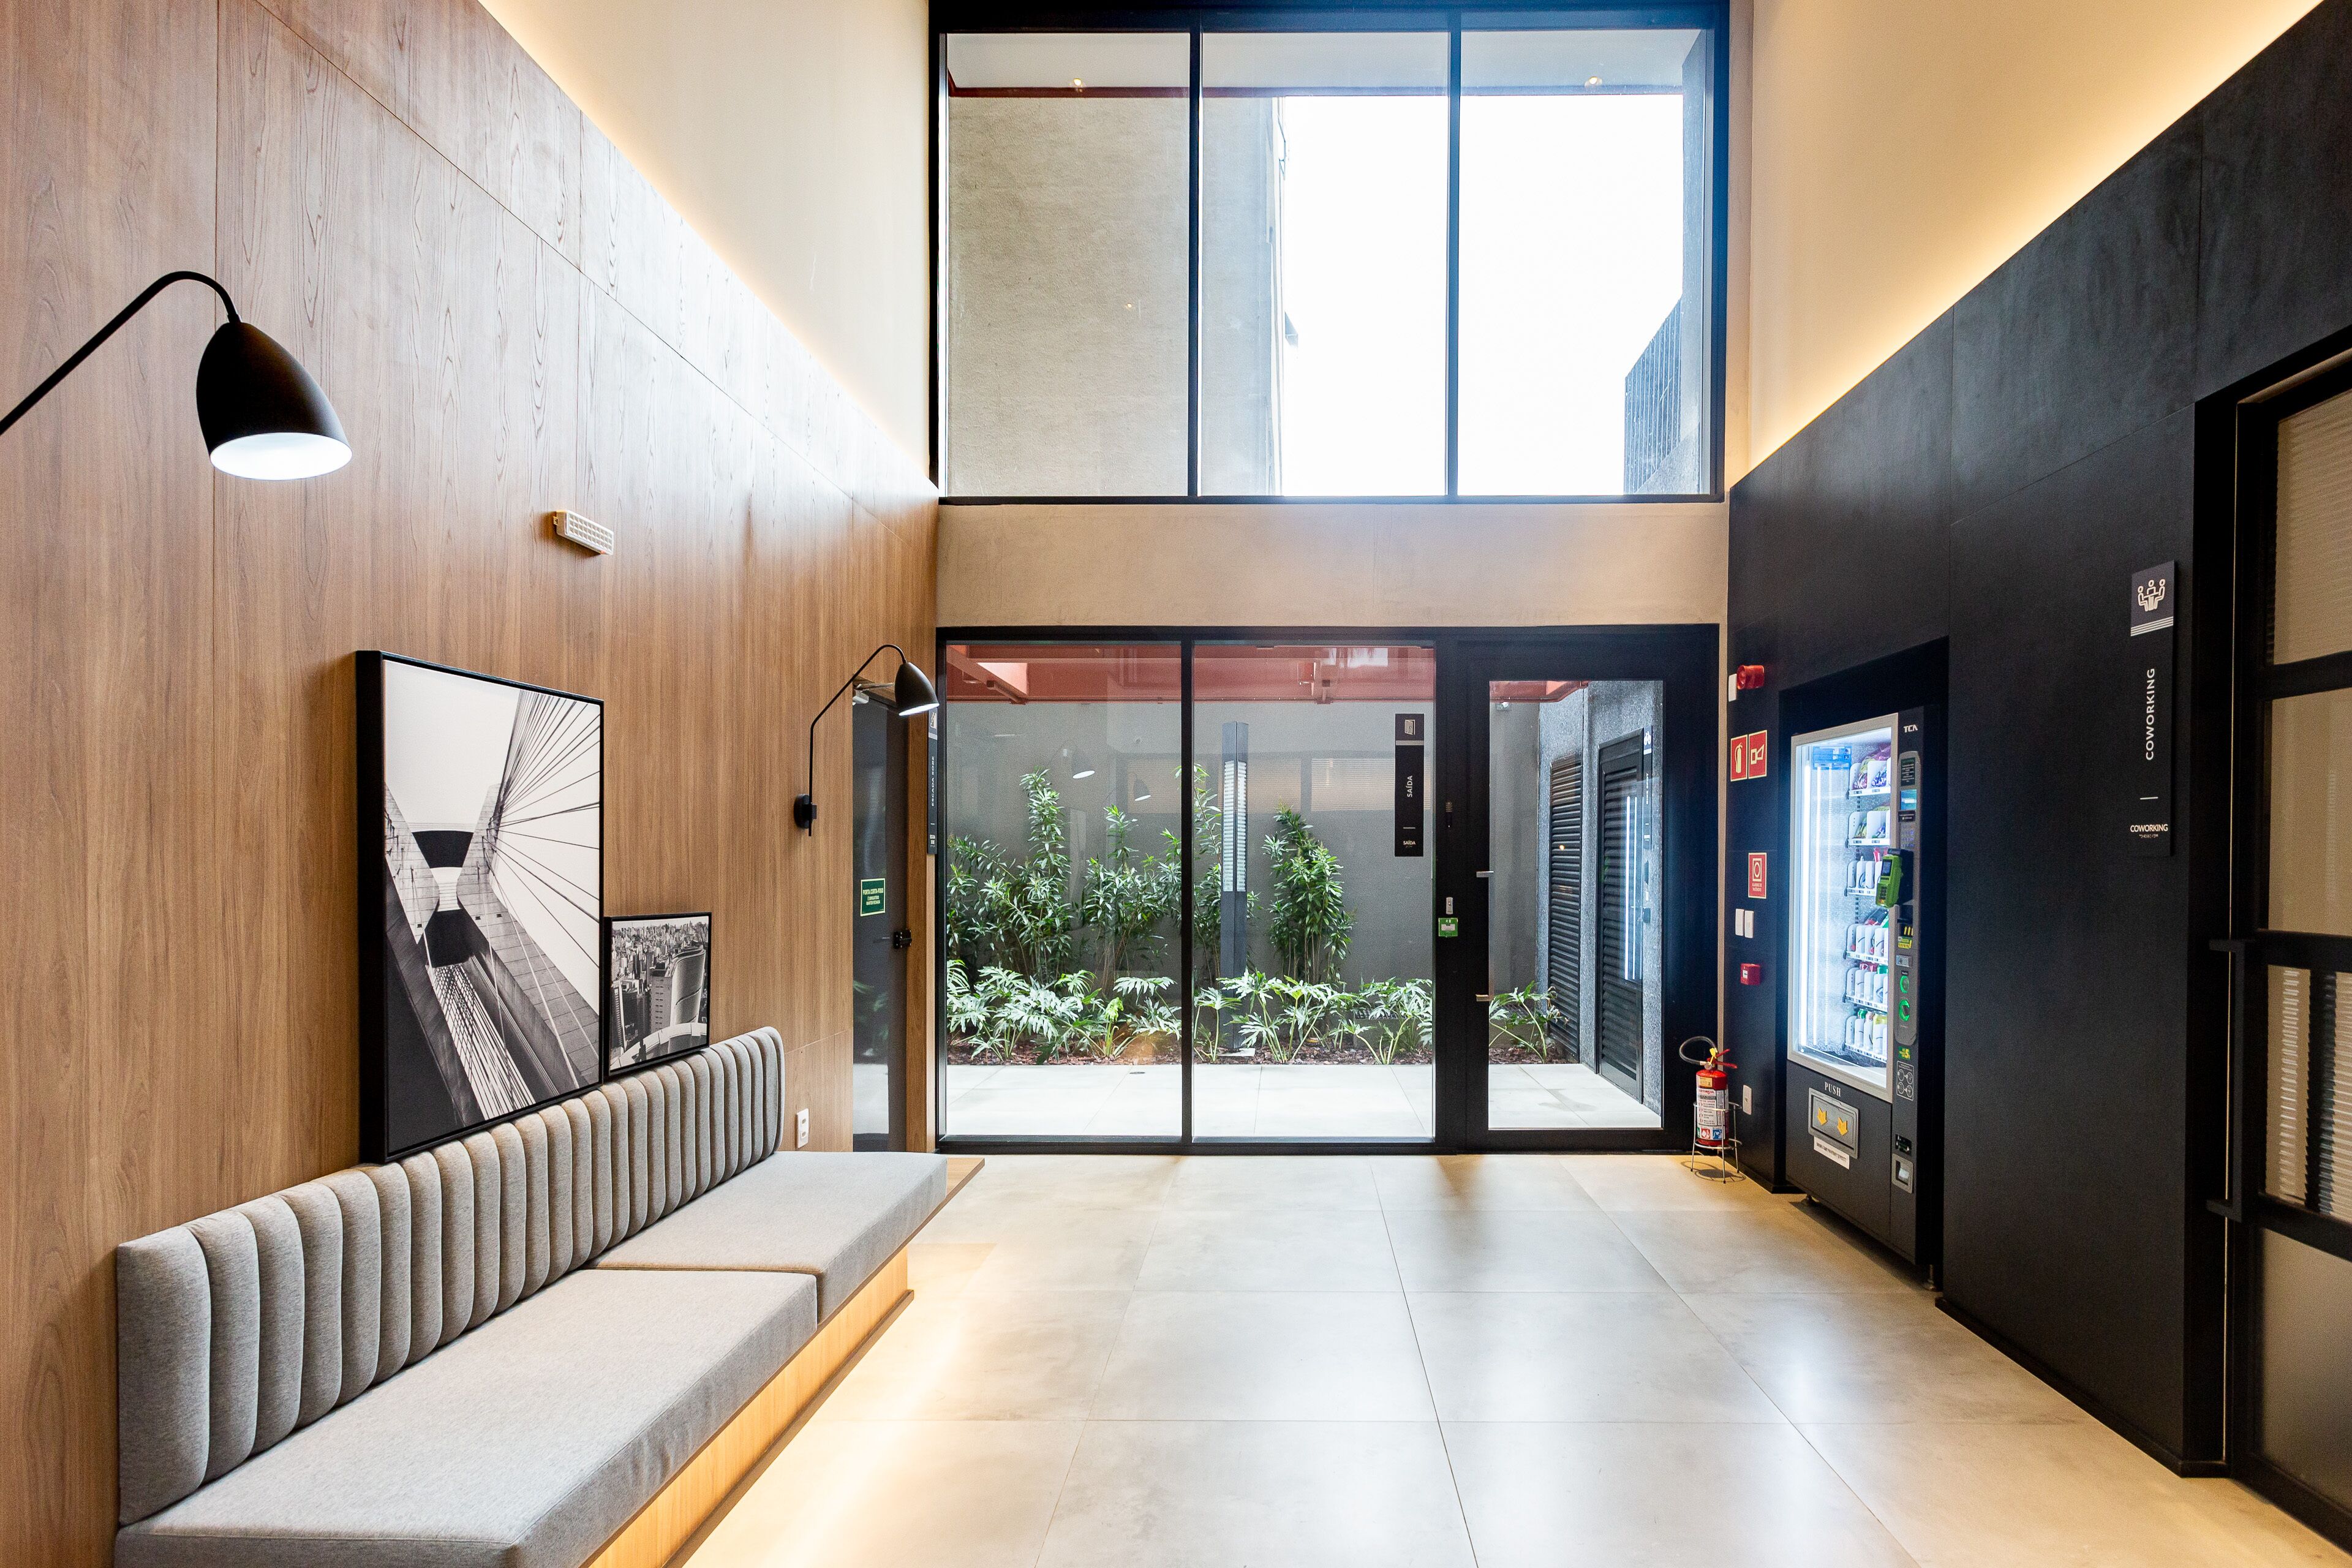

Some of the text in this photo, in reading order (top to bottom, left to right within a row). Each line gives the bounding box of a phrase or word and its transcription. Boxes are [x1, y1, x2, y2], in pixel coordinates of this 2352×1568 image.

[2146, 668, 2155, 761] COWORKING
[1903, 724, 1918, 733] TCA
[2130, 823, 2168, 832] COWORKING
[1825, 1081, 1841, 1098] PUSH
